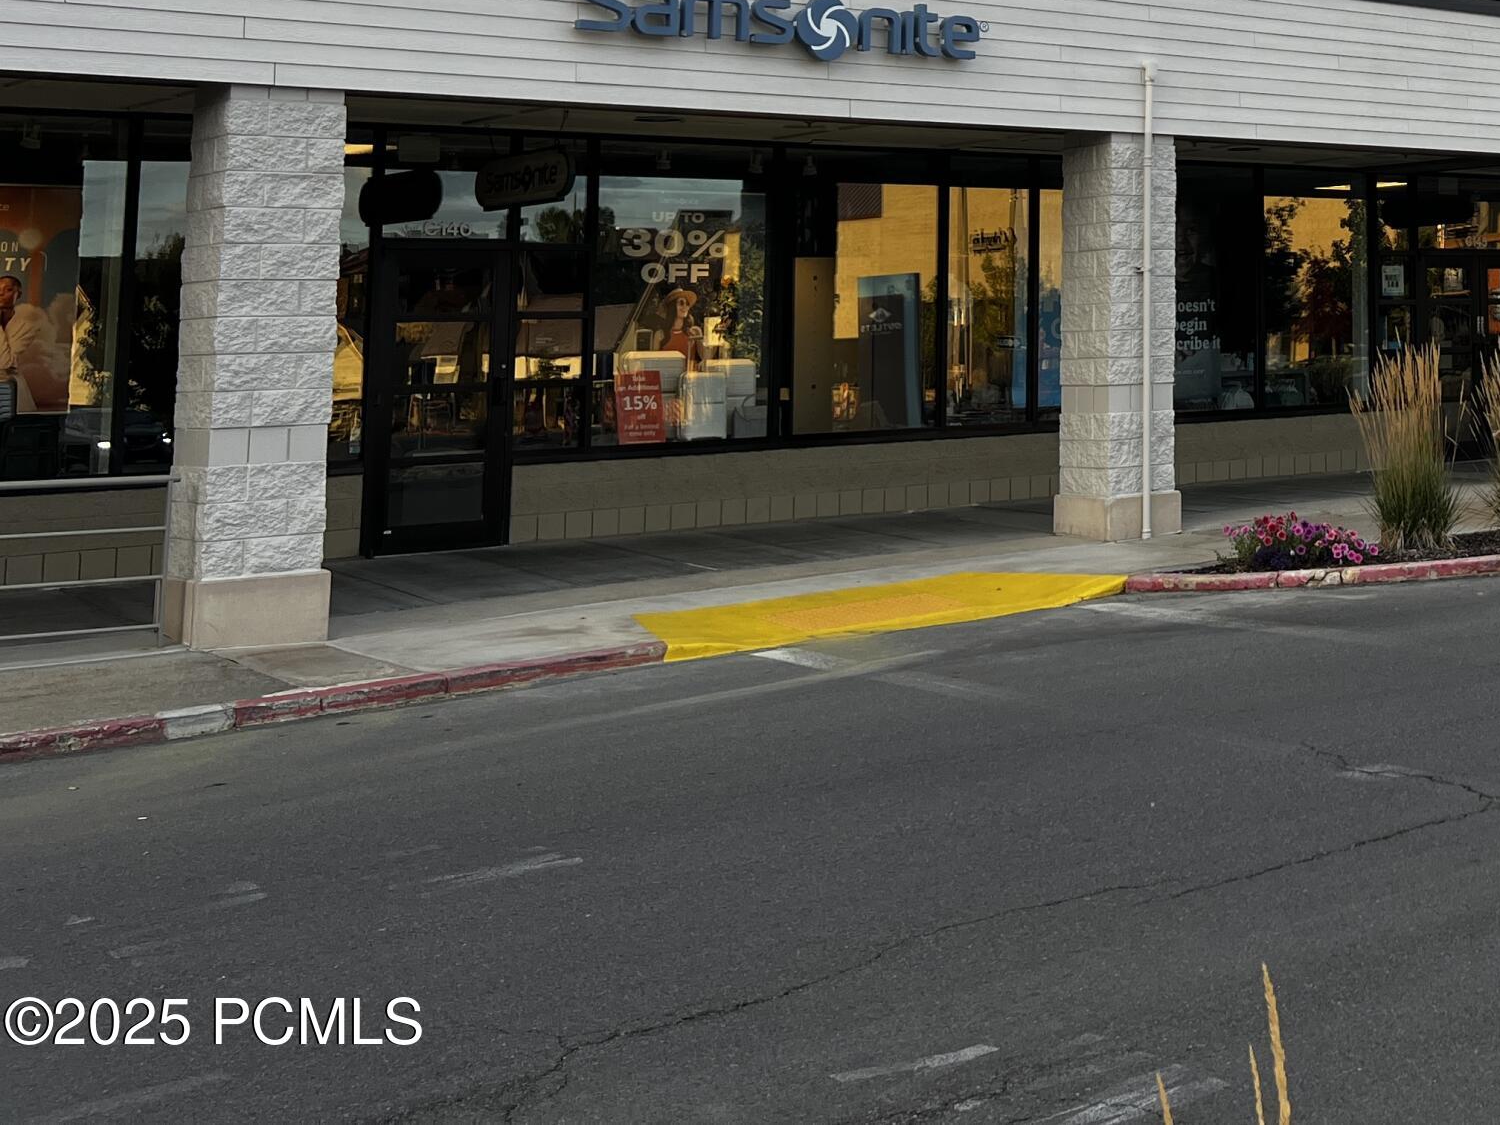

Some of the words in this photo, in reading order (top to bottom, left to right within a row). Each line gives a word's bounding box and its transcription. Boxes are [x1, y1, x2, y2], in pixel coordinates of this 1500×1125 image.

[652, 211, 675, 223] UP
[680, 212, 705, 224] TO
[622, 228, 729, 258] 30%
[640, 263, 710, 284] OFF
[1176, 298, 1216, 312] oesn't
[1176, 335, 1210, 350] cribe
[624, 395, 658, 411] 15%
